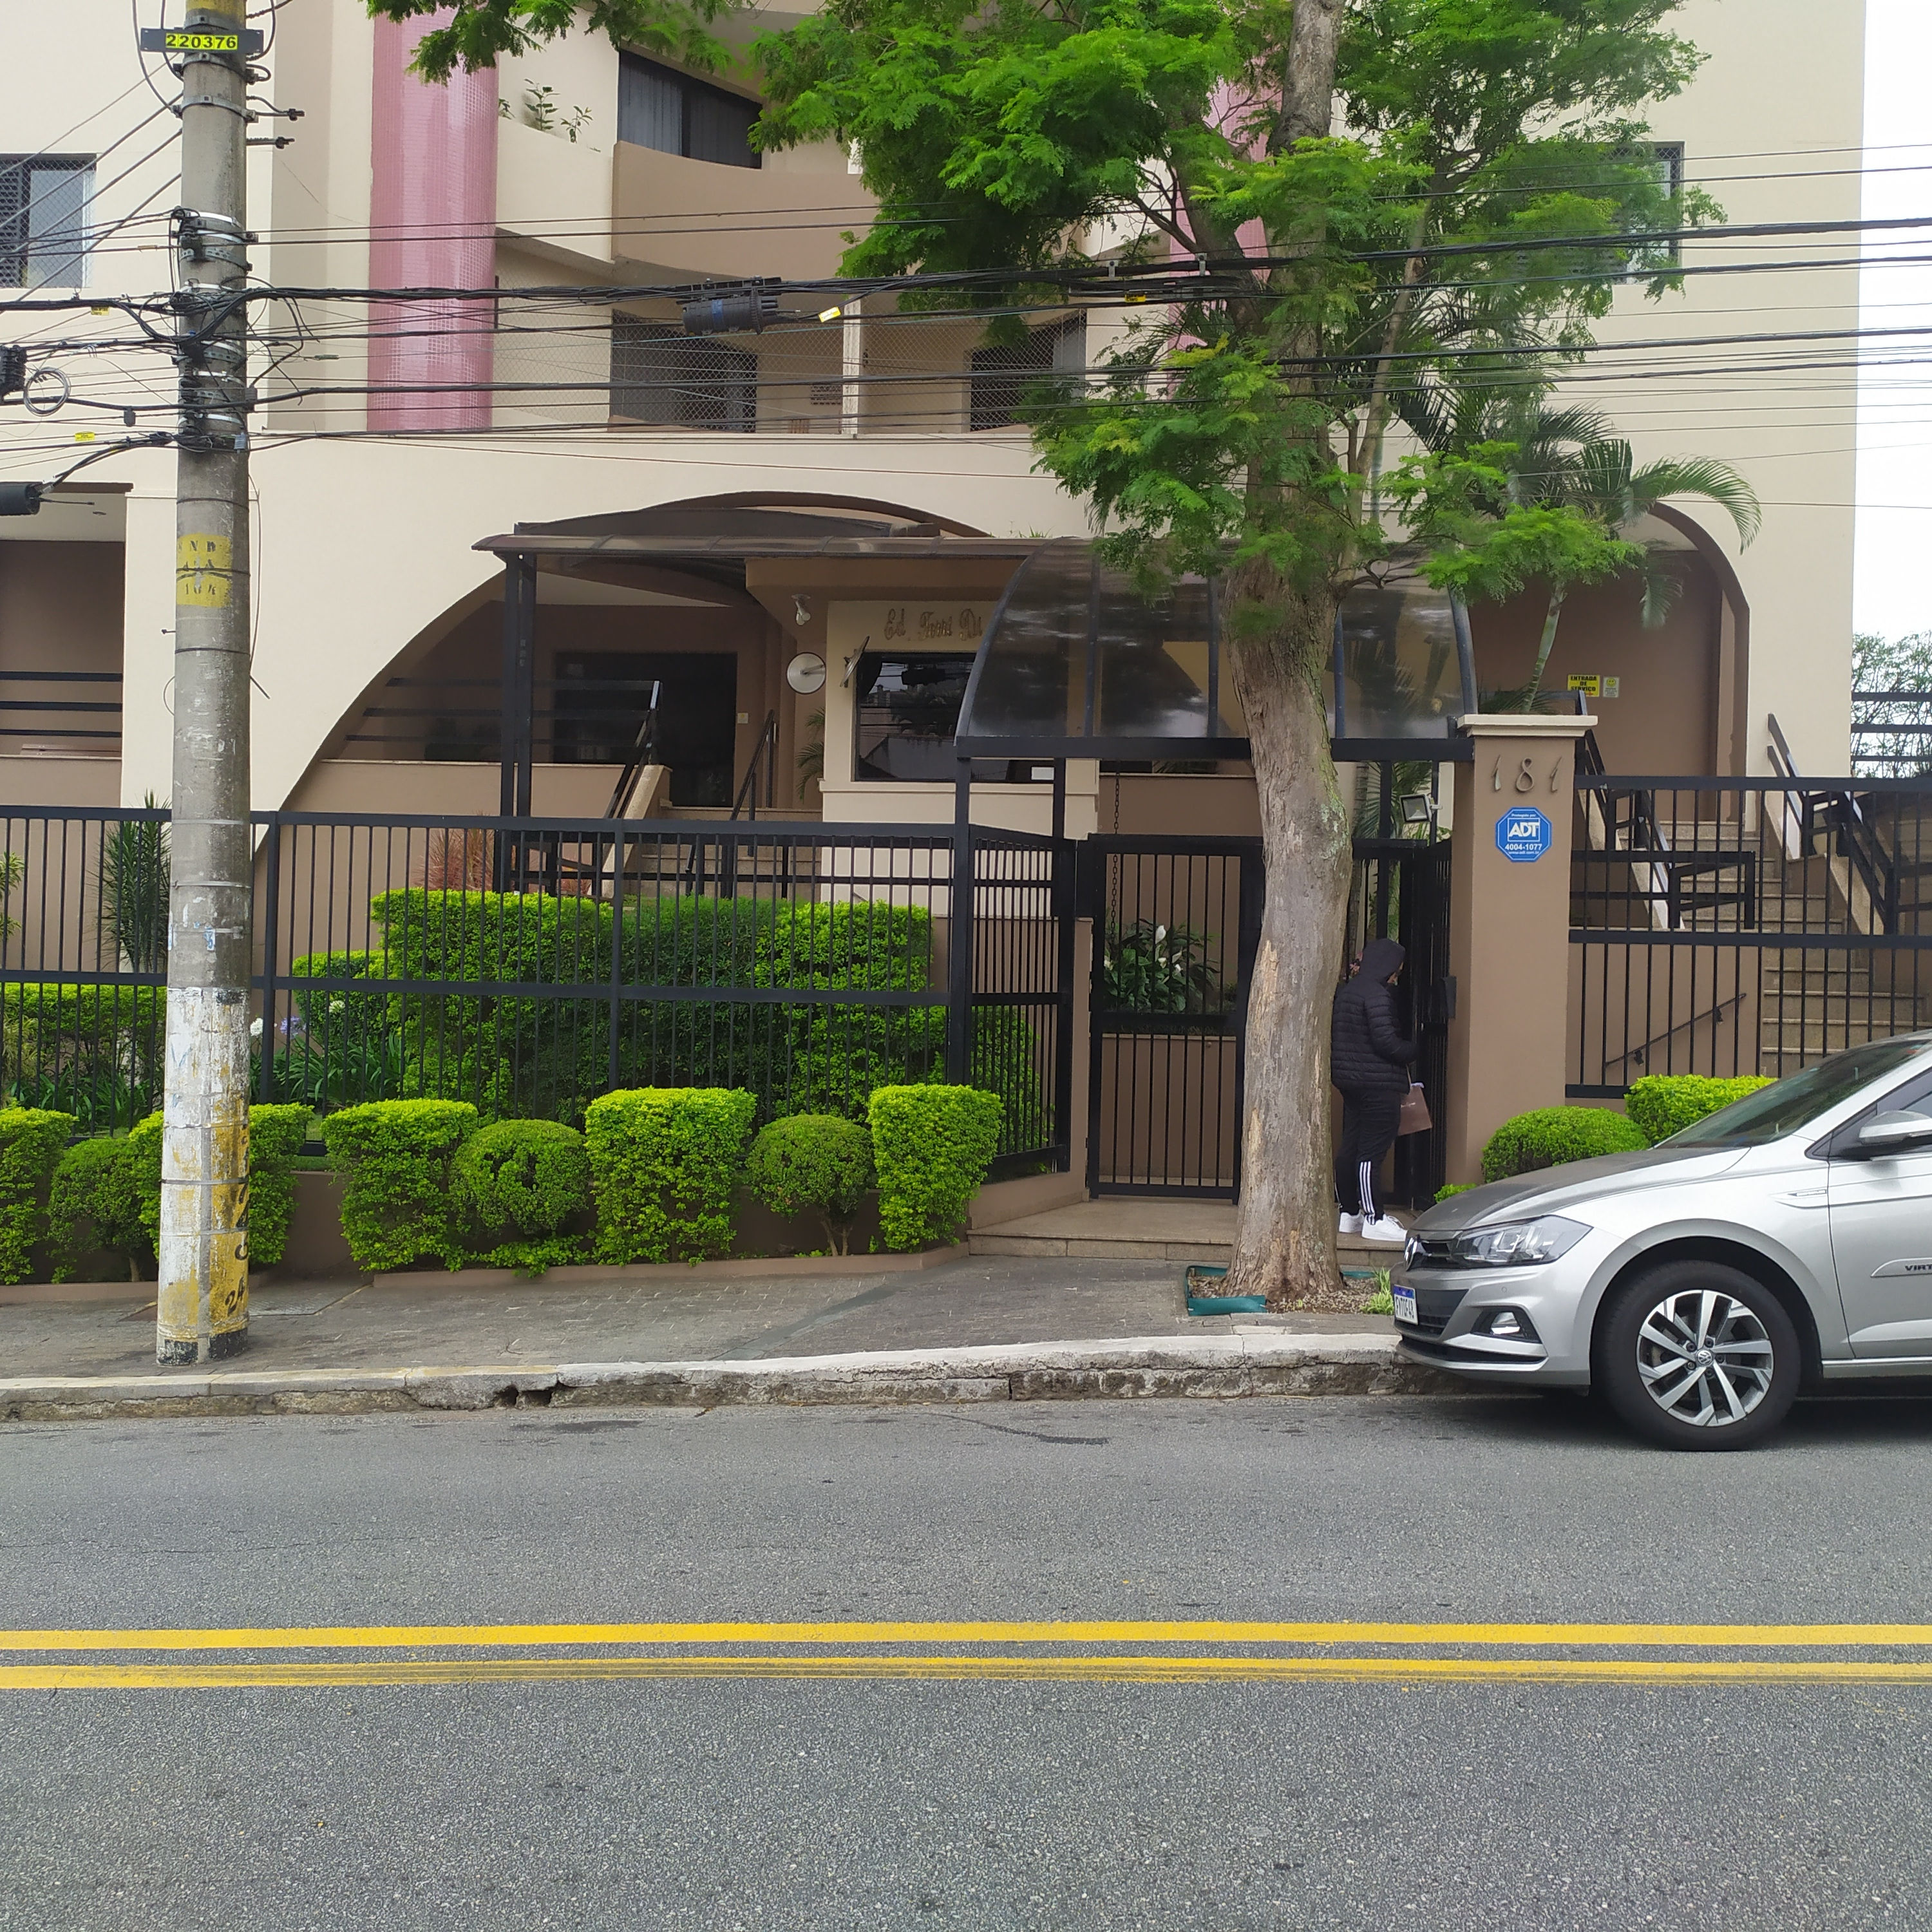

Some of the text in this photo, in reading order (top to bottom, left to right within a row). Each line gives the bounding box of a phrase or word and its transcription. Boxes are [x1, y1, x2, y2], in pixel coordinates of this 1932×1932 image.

[166, 34, 236, 48] 220376
[1491, 754, 1562, 793] 181
[1508, 822, 1540, 837] ADT
